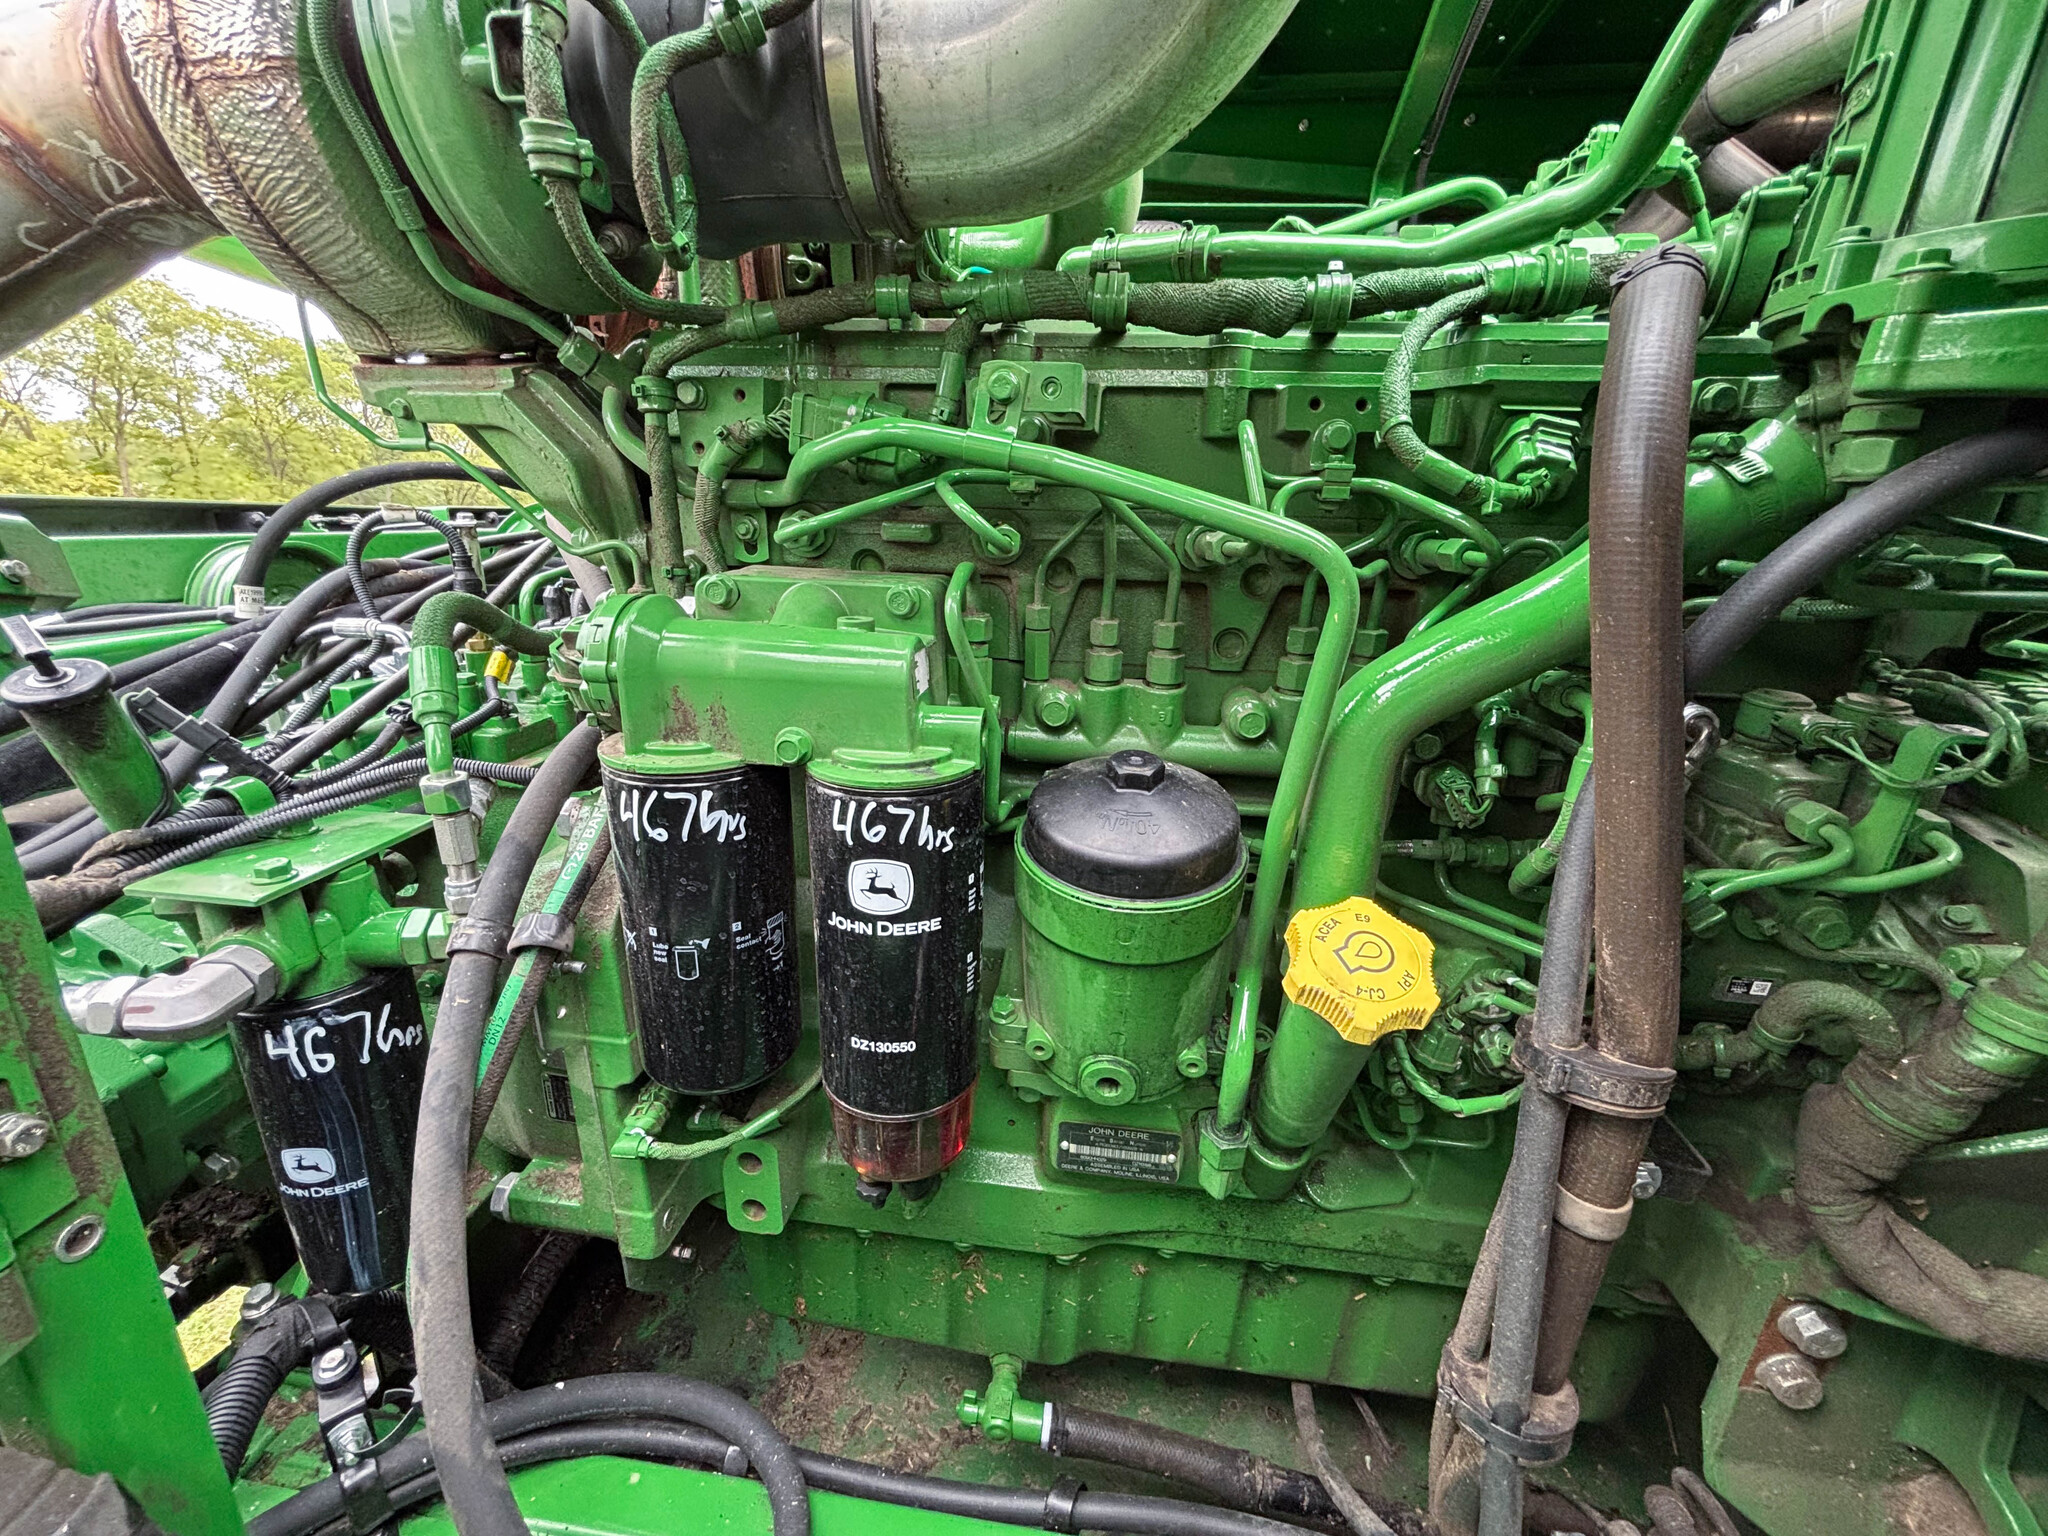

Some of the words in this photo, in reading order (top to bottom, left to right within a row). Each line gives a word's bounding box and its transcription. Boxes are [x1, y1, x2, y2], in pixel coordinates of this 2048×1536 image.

[832, 799, 956, 853] 467hrs
[828, 911, 873, 936] JOHN
[876, 917, 942, 937] DEERE
[1315, 917, 1342, 942] ACEA
[1354, 913, 1371, 923] E9
[652, 942, 669, 950] Lube
[735, 933, 752, 943] Seal
[736, 936, 763, 950] contact
[1397, 970, 1416, 992] API
[1356, 985, 1386, 1000] CJ-4
[488, 1016, 506, 1046] DN12
[850, 1036, 917, 1053] DZ130550
[1088, 1127, 1115, 1137] JOHN
[1118, 1130, 1150, 1141] DEERE
[280, 1181, 310, 1199] JOHN
[310, 1177, 370, 1198] DEERE
